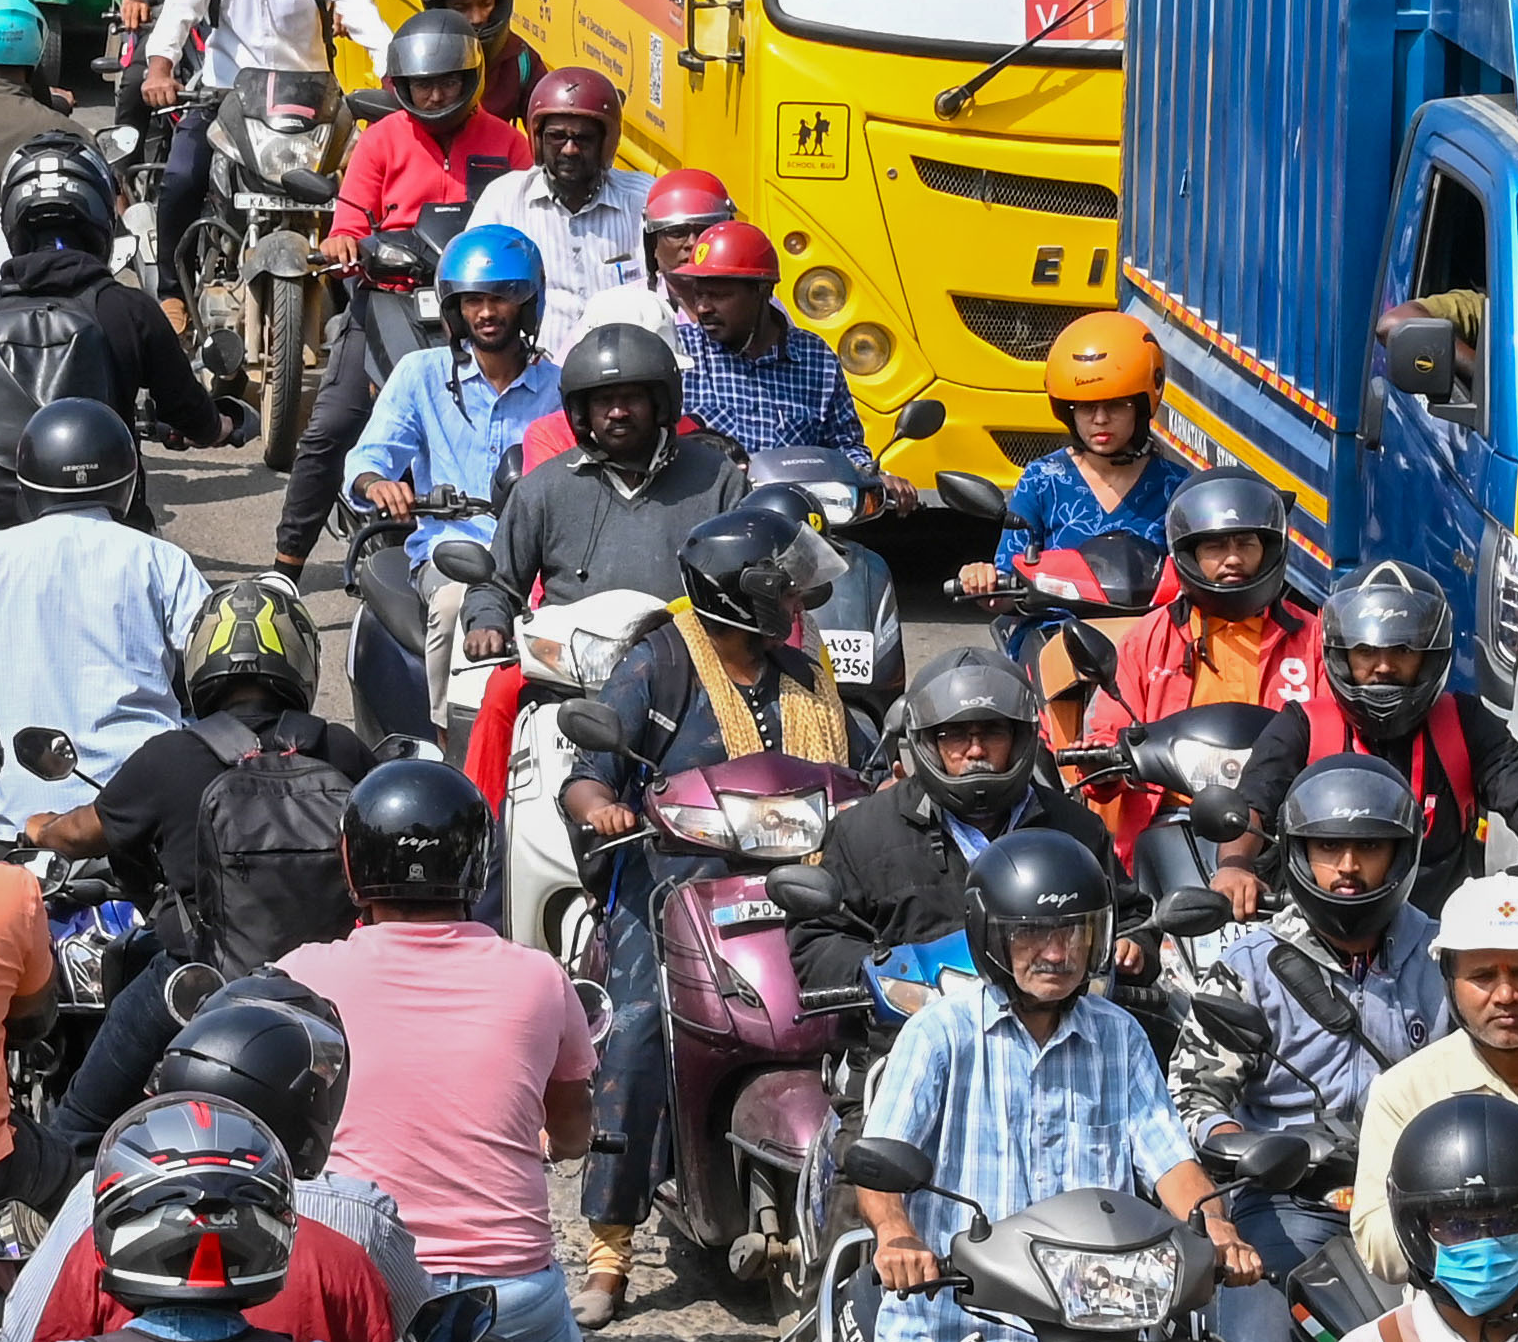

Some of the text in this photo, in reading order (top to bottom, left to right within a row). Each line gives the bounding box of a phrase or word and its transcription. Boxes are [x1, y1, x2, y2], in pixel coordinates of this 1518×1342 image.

[786, 160, 836, 170] SCHOOL BUS
[1167, 407, 1209, 462] KARNATAKA
[781, 457, 826, 466] HONDA
